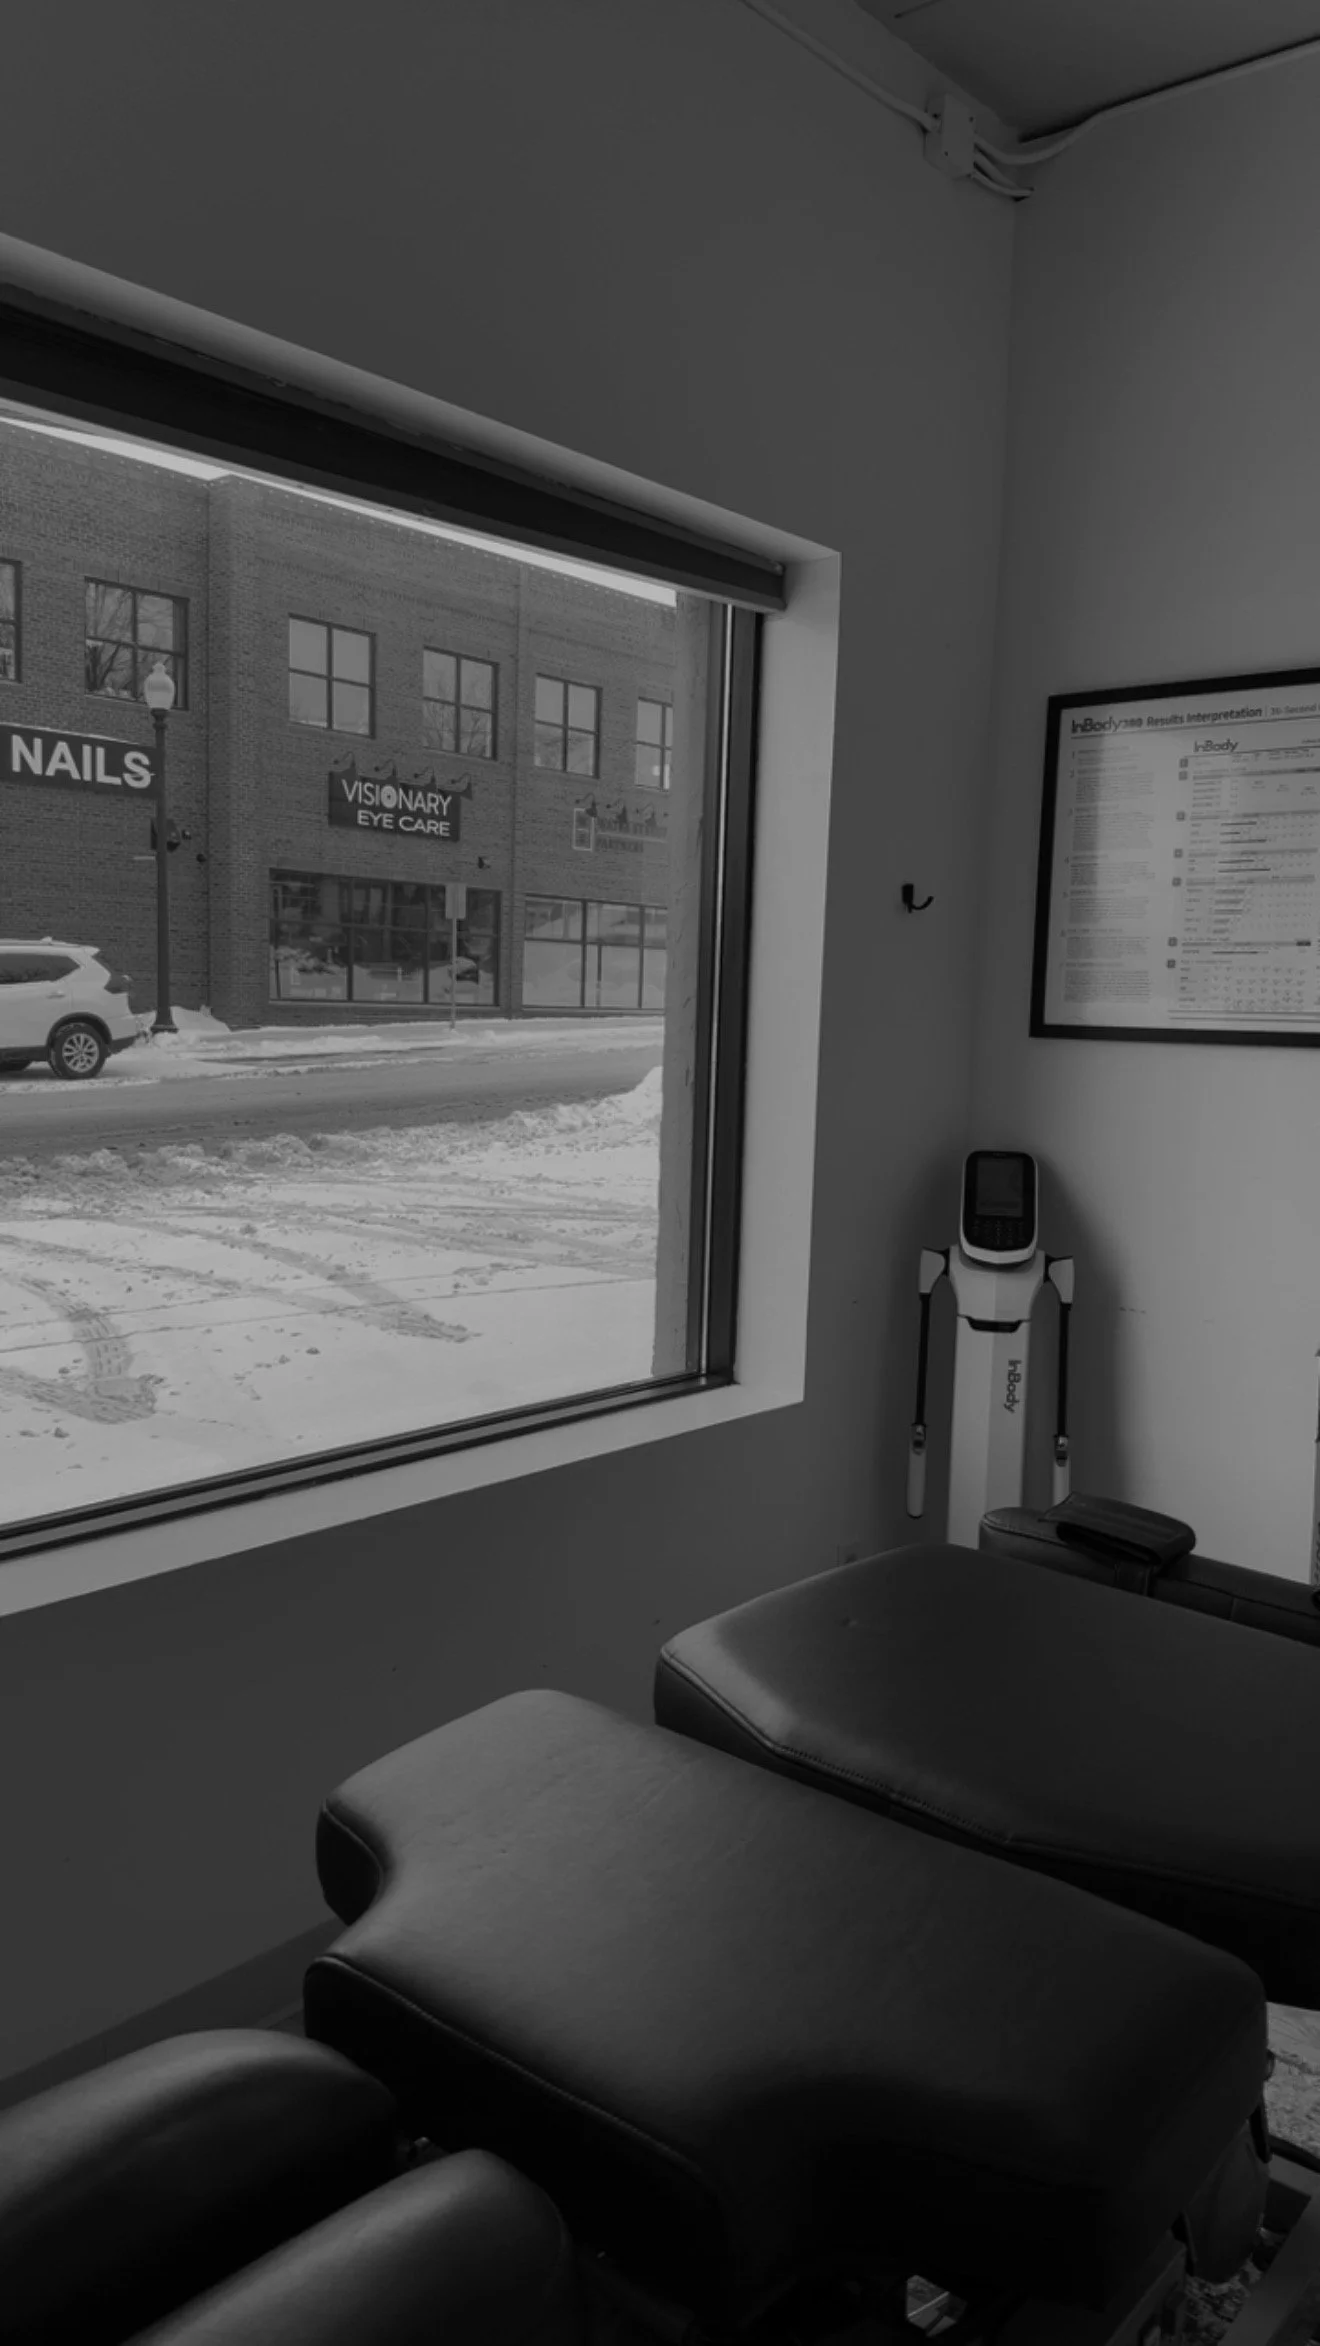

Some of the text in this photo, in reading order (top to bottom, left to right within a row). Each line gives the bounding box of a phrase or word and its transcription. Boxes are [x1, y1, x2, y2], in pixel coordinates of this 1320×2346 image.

[1146, 715, 1184, 728] Results
[1187, 707, 1262, 723] Interpretation
[1194, 738, 1239, 752] InBody
[12, 734, 151, 789] NAILS
[342, 779, 452, 816] VISIONARY
[357, 809, 451, 837] EYE CARE
[1003, 1359, 1022, 1413] InBody
